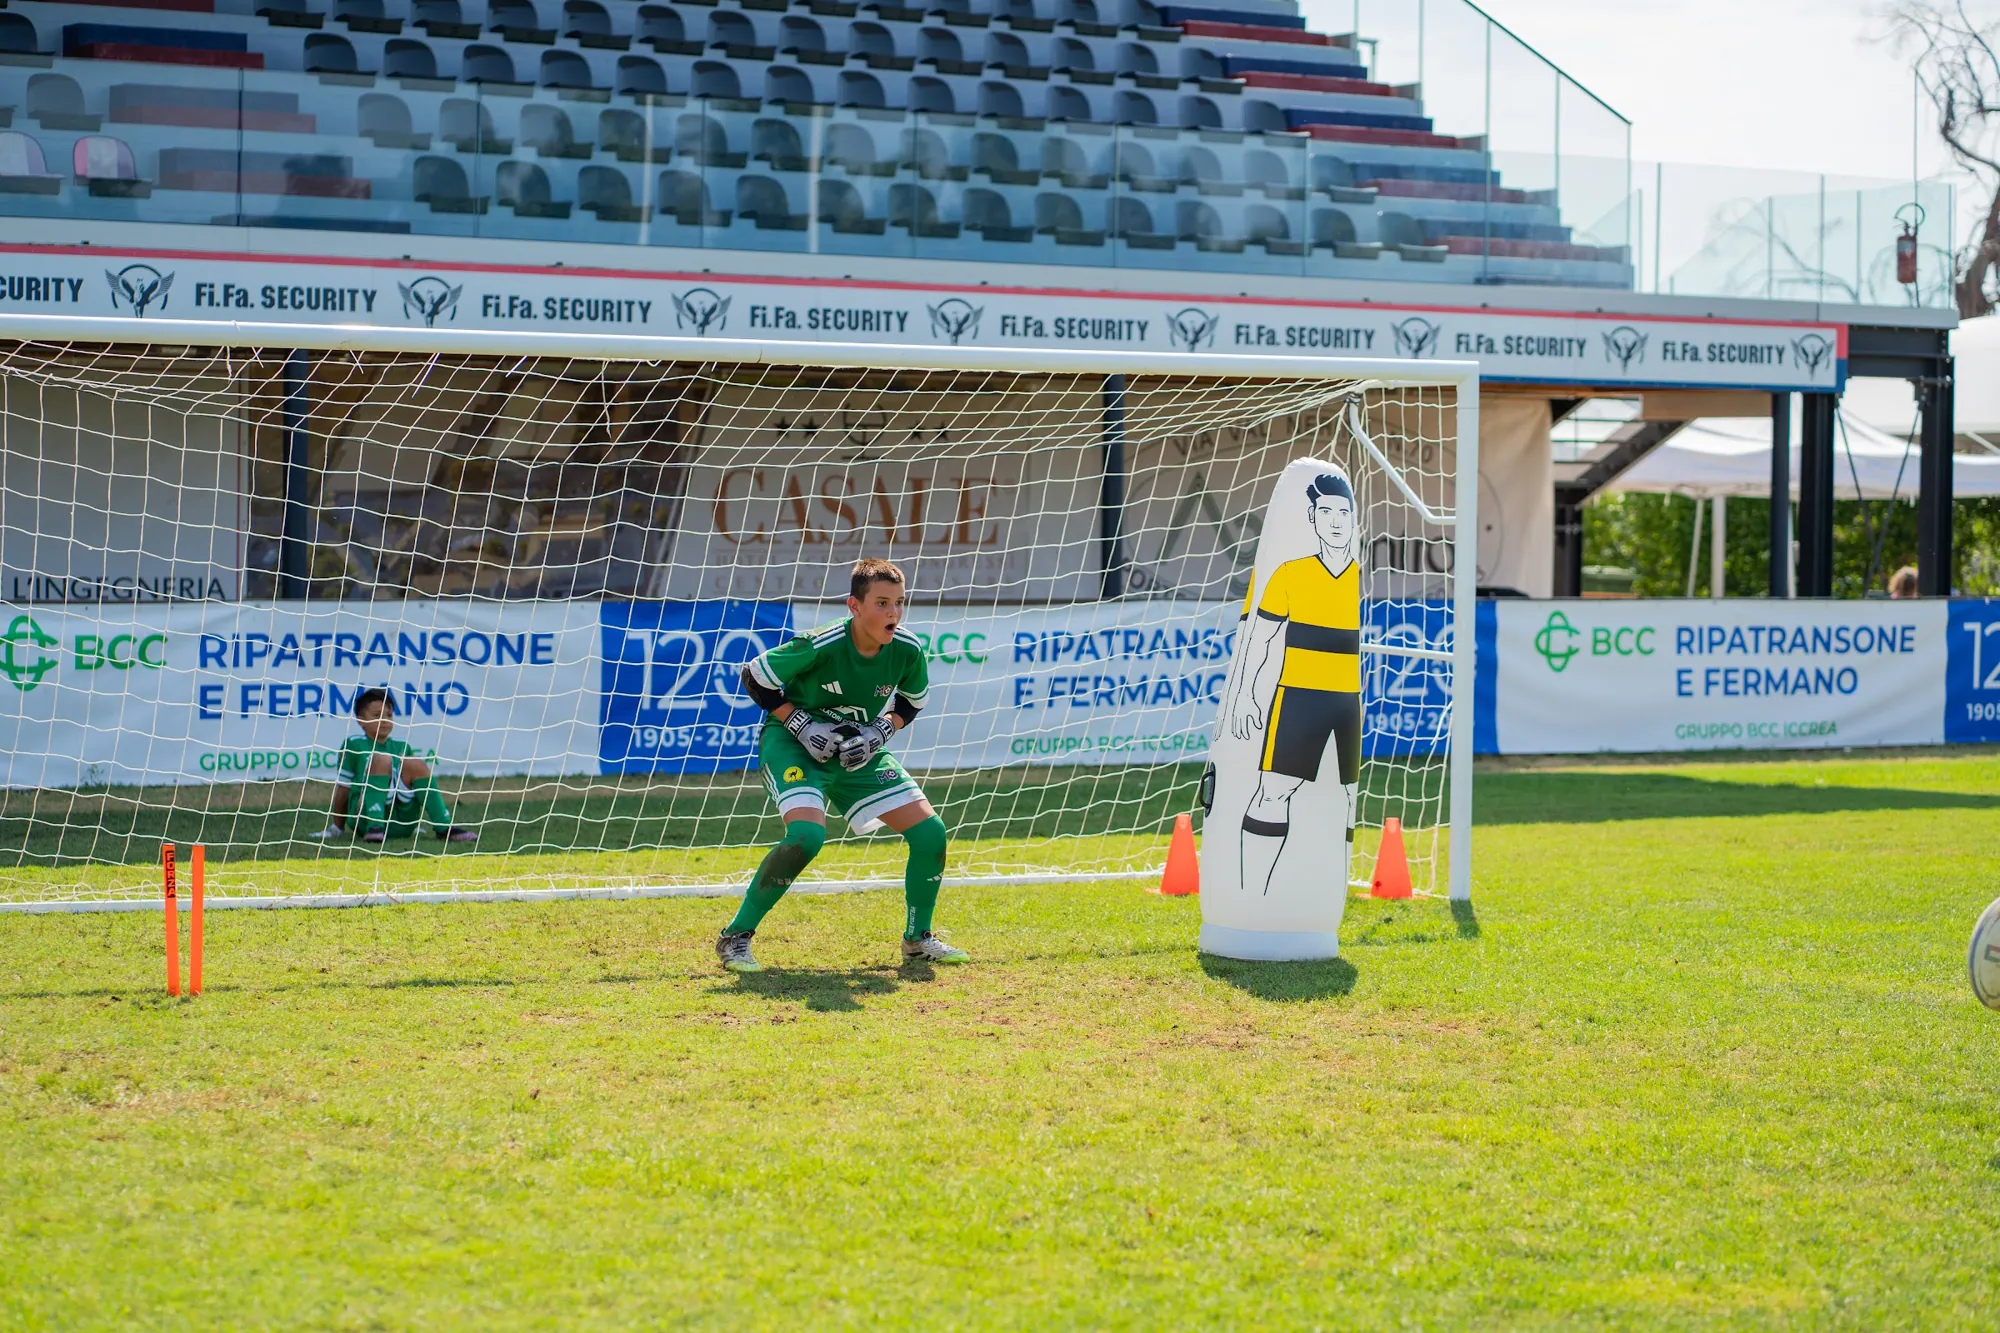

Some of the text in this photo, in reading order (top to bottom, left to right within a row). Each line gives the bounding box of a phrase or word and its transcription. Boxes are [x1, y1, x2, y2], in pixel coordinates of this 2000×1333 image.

[194, 282, 377, 312] Fi.Fa. SECURITY
[482, 294, 652, 323] Fi.Fa. SECURITY
[750, 305, 908, 332] Fi.Fa. SECURITY
[1000, 315, 1148, 341] Fi.Fa. SECURITY
[1235, 324, 1375, 349] Fi.Fa. SECURITY
[1456, 333, 1586, 358] Fi.Fa. SECURITY
[1662, 341, 1785, 364] Fi.Fa. SECURITY
[711, 468, 998, 546] CASALE
[14, 576, 226, 600] L'INGEGNERIA
[74, 634, 168, 671] BCC
[199, 632, 555, 669] RIPATRANSONE
[1591, 627, 1656, 656] BCC
[1676, 625, 1917, 656] RIPATRANSONE
[626, 629, 768, 711] 120
[1677, 666, 1858, 697] E FERMANO
[199, 684, 225, 720] E
[1015, 673, 1227, 709] E FERMANO
[1011, 734, 1208, 755] GRUPPO BCC ICCREA
[1675, 721, 1838, 740] GRUPPO BCC ICCREA
[199, 751, 337, 772] GRUPPO BC
[165, 850, 176, 898] FORZA
